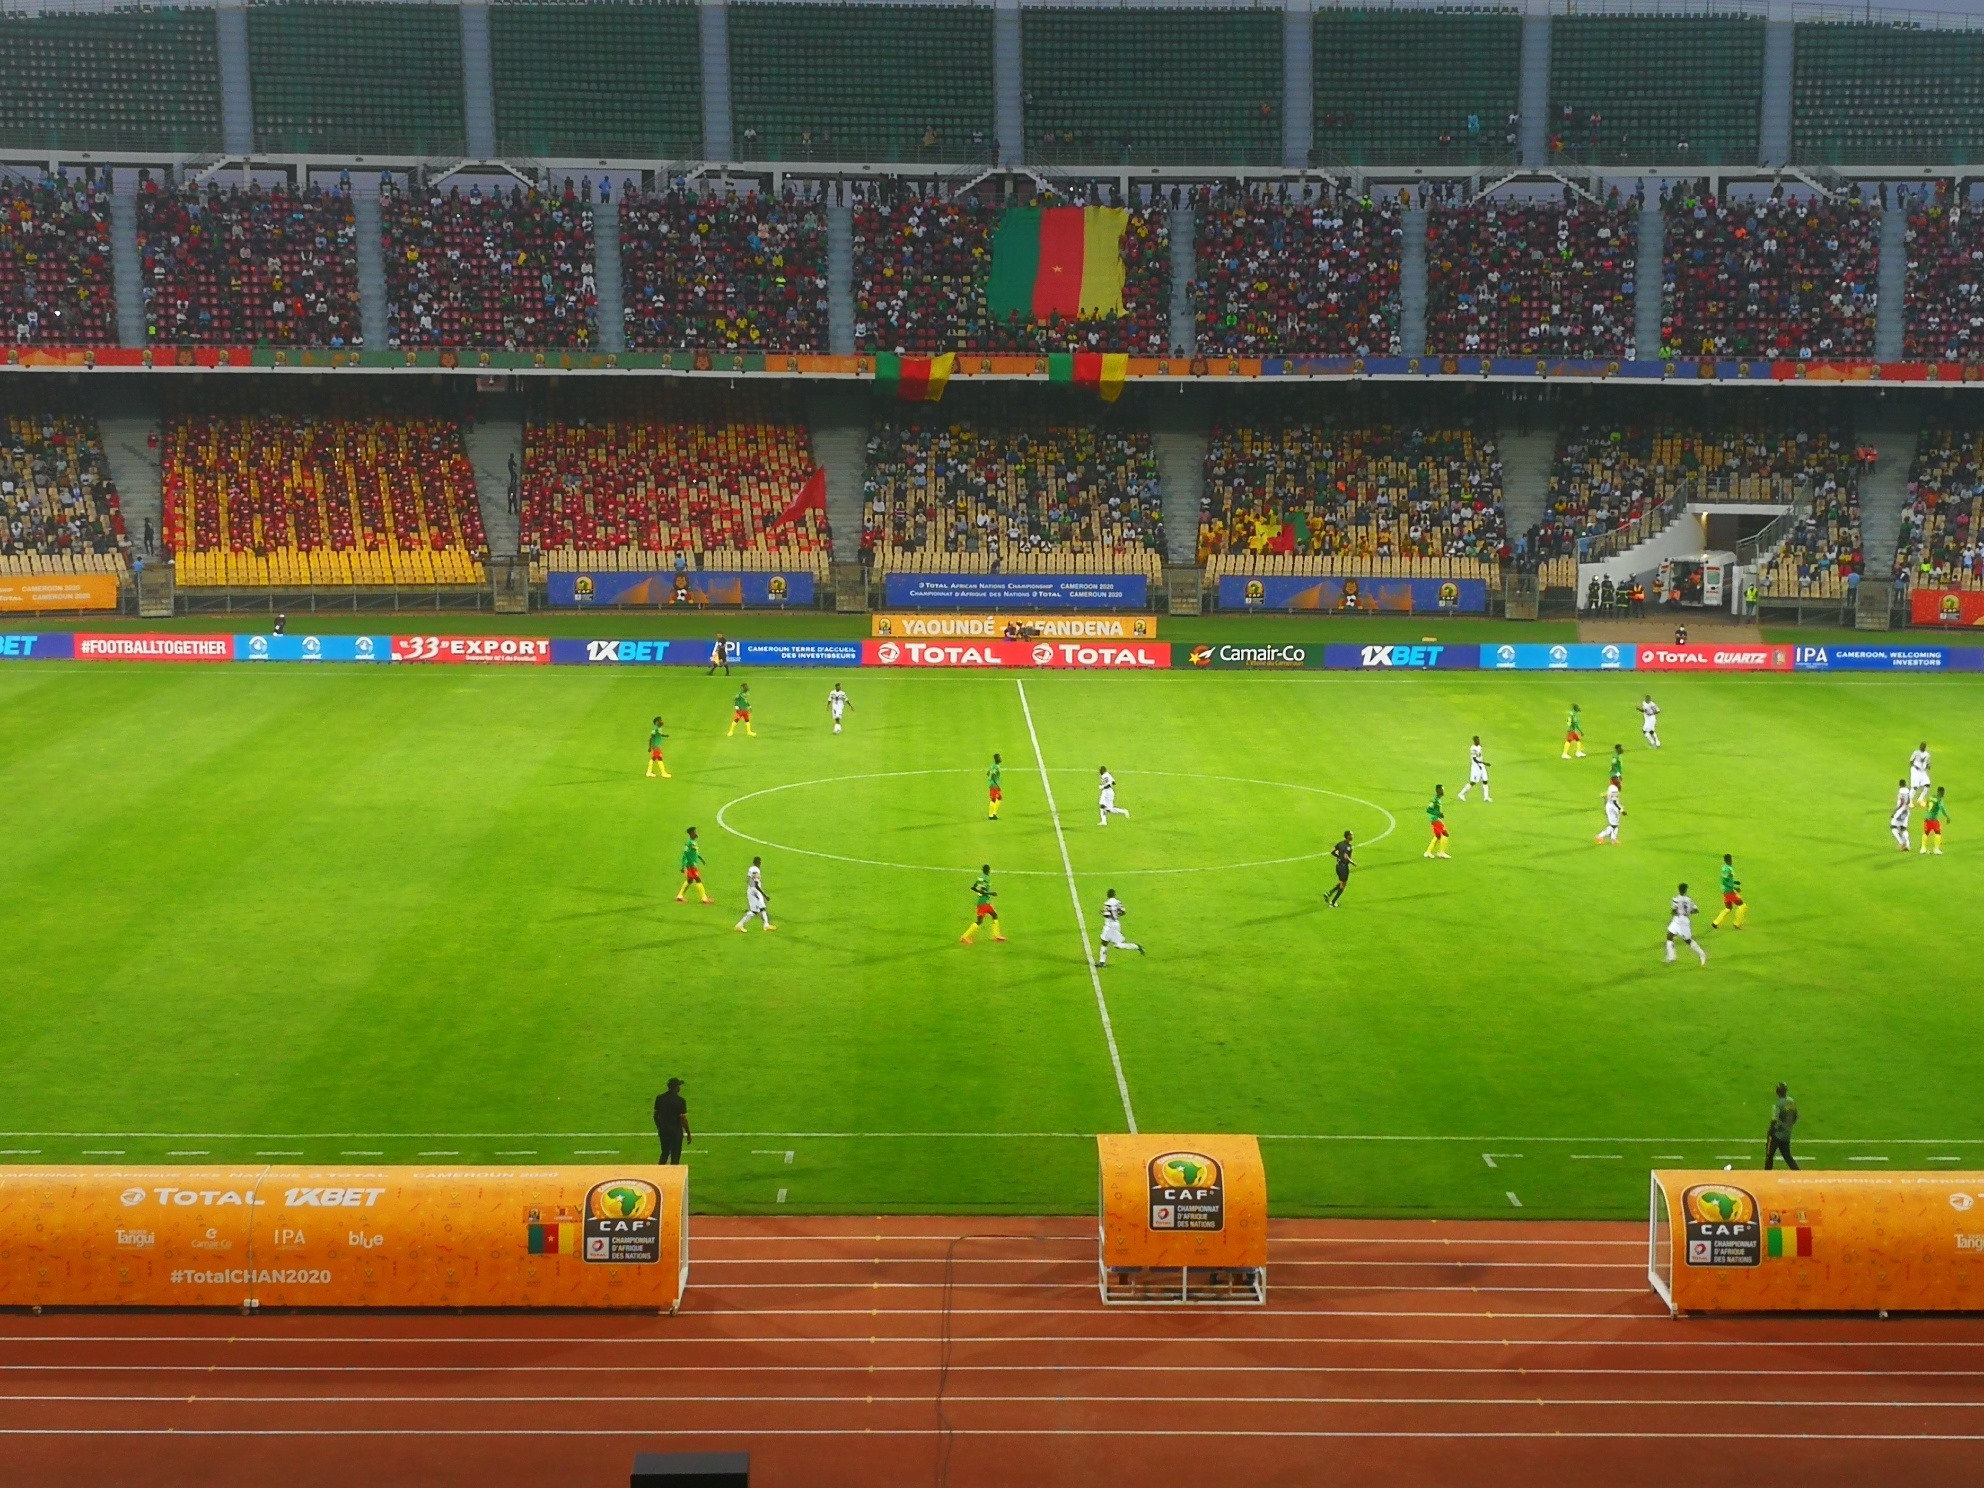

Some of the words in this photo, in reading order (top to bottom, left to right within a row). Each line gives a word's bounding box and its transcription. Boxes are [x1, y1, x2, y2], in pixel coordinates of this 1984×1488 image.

[901, 616, 996, 636] YAOUNDÉ
[1022, 620, 1124, 636] FANDENA
[0, 635, 38, 655] ET
[81, 639, 226, 654] #FOOTBALLTOGETHER
[450, 640, 549, 655] EXPORT
[586, 641, 670, 661] 1XBET
[1219, 644, 1306, 661] Camair-Co
[904, 642, 1002, 664] TOTAL
[1058, 643, 1156, 665] TOTAL
[1361, 645, 1444, 666] 1XBET
[1656, 650, 1708, 663] TOTAL
[1713, 651, 1767, 664] QUARTZ
[1796, 647, 1828, 662] IPA
[1836, 651, 1887, 659] CAMEROON,
[153, 1187, 266, 1206] TOTAL
[284, 1187, 386, 1206] 1XBET
[1164, 1189, 1208, 1200] CAF
[600, 1220, 644, 1232] CAF
[1177, 1220, 1189, 1228] DES
[1189, 1220, 1216, 1228] NATIONS
[1700, 1224, 1745, 1235] CAF
[114, 1229, 155, 1248] Tangui
[274, 1229, 306, 1244] IPA
[348, 1230, 384, 1249] blue
[611, 1236, 655, 1244] CHAMPIONNAT
[1713, 1240, 1757, 1248] CHAMPIONNAT
[1953, 1233, 1984, 1251] Tang
[611, 1244, 643, 1252] D'AFRIQUE
[1713, 1248, 1745, 1256] D'AFRIQUE
[611, 1252, 624, 1260] DES
[625, 1252, 651, 1260] NATIONS
[170, 1269, 332, 1284] #TotalCHAN2020
